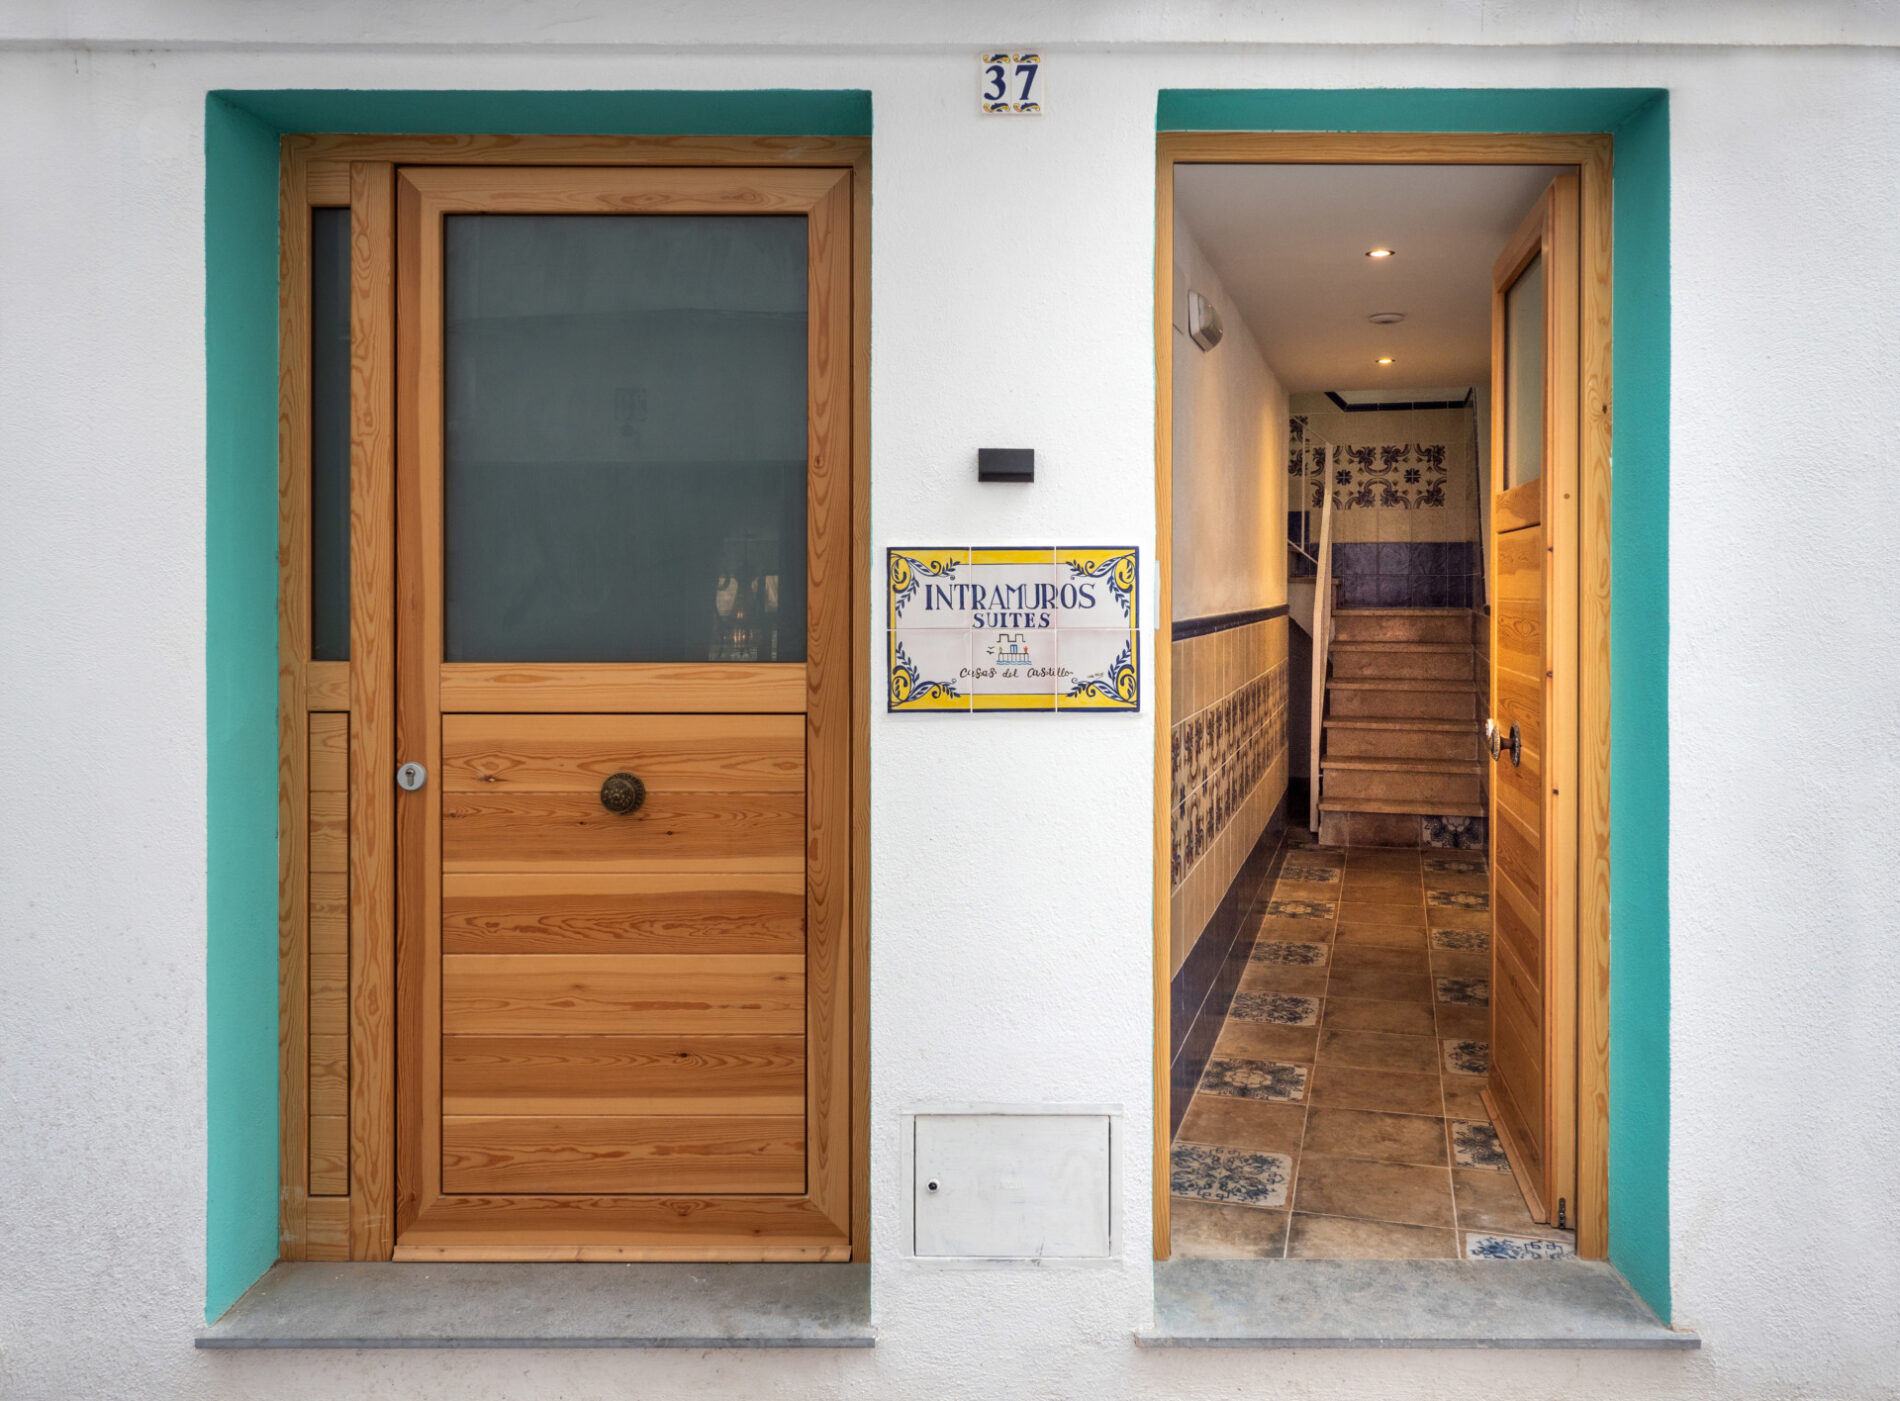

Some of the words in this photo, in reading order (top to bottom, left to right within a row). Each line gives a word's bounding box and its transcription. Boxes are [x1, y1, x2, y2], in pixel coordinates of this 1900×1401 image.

[984, 64, 1038, 101] 37
[925, 583, 1096, 611] INTRAMUROS
[972, 612, 1051, 629] SUITES
[959, 667, 997, 679] Casas
[1002, 667, 1019, 679] del
